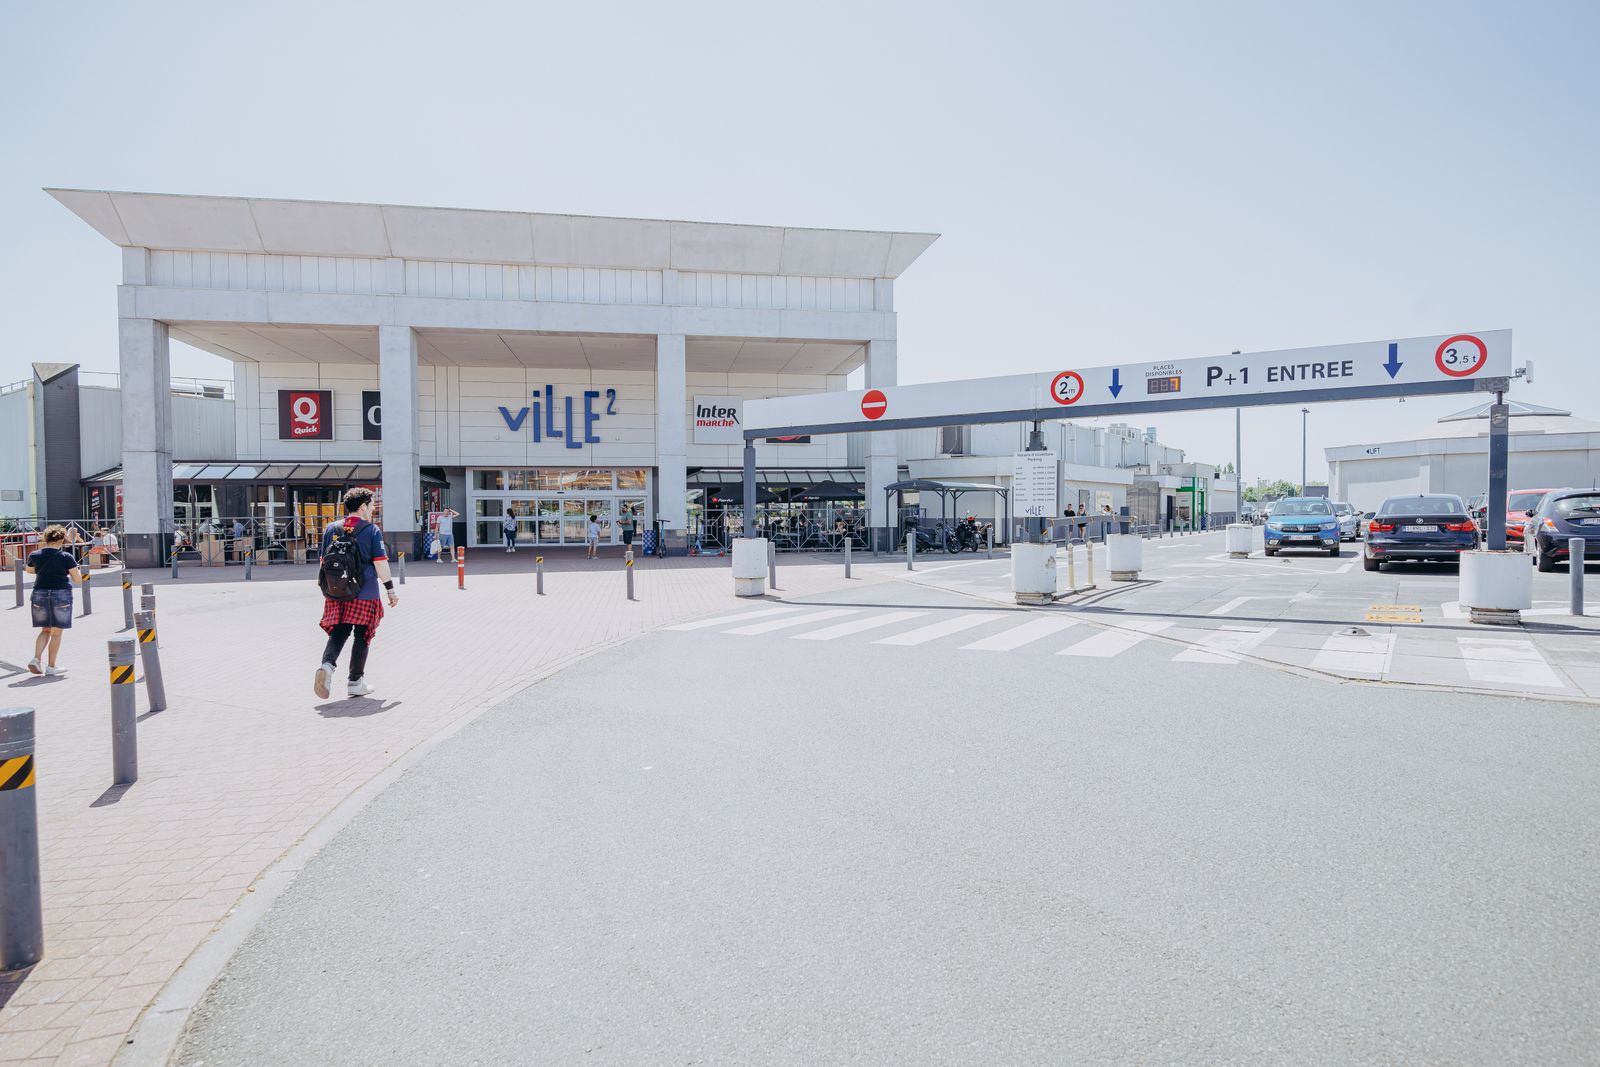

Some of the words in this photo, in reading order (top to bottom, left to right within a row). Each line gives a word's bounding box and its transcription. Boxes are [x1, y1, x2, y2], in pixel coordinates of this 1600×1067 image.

[1145, 369, 1183, 377] DISPONIBLES
[1206, 365, 1248, 387] P+1
[1266, 360, 1353, 383] ENTREE
[696, 419, 736, 427] marché
[295, 425, 318, 435] Quick
